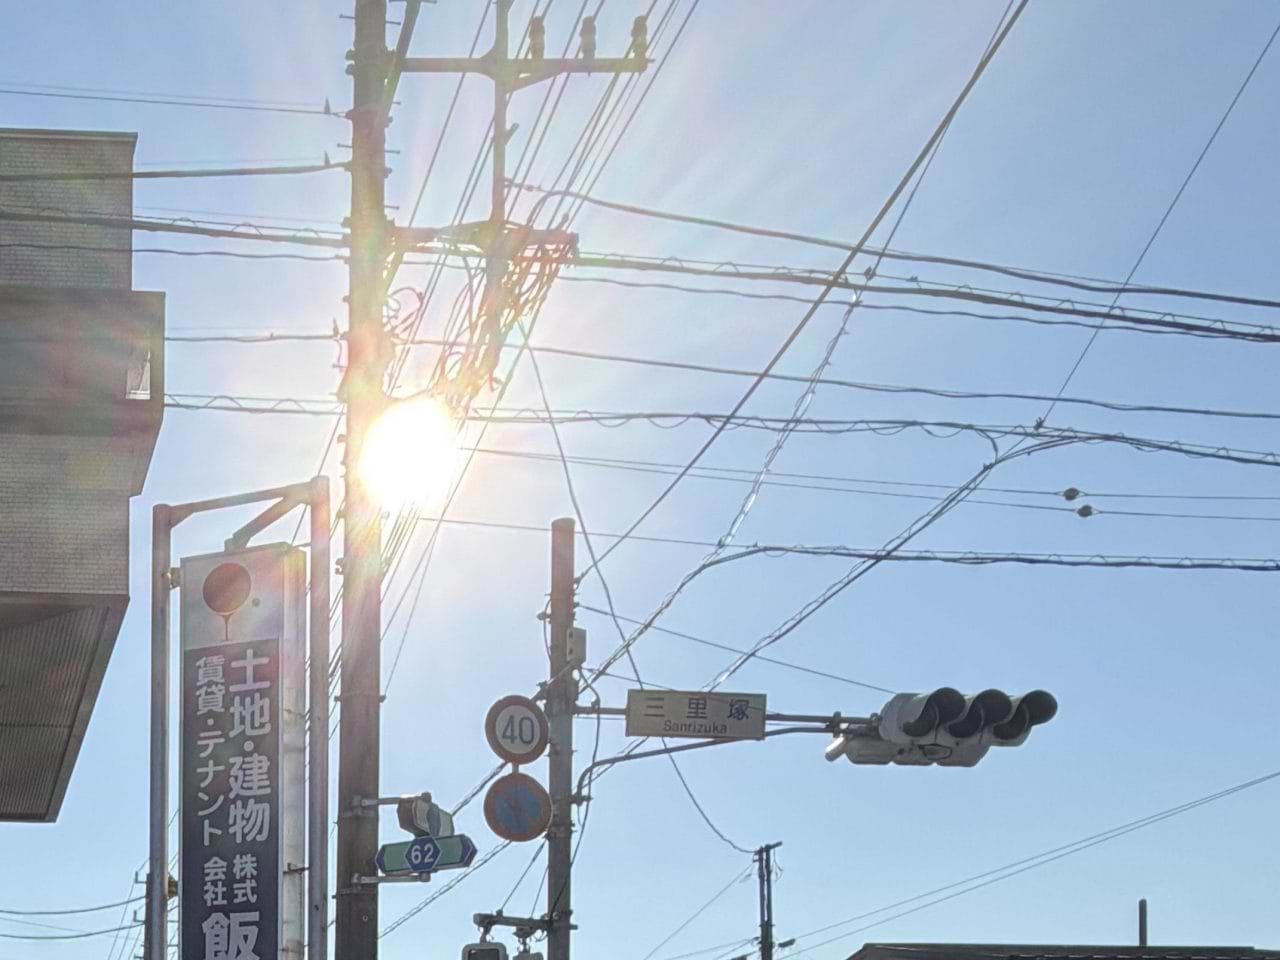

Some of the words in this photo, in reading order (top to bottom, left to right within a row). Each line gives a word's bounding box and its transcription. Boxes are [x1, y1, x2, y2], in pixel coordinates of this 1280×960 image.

[643, 696, 750, 720] 三里塚
[501, 714, 535, 744] 40
[664, 720, 728, 734] Sanrizuka
[409, 843, 436, 864] 62
[203, 856, 228, 906] 会社
[232, 853, 258, 904] 株式
